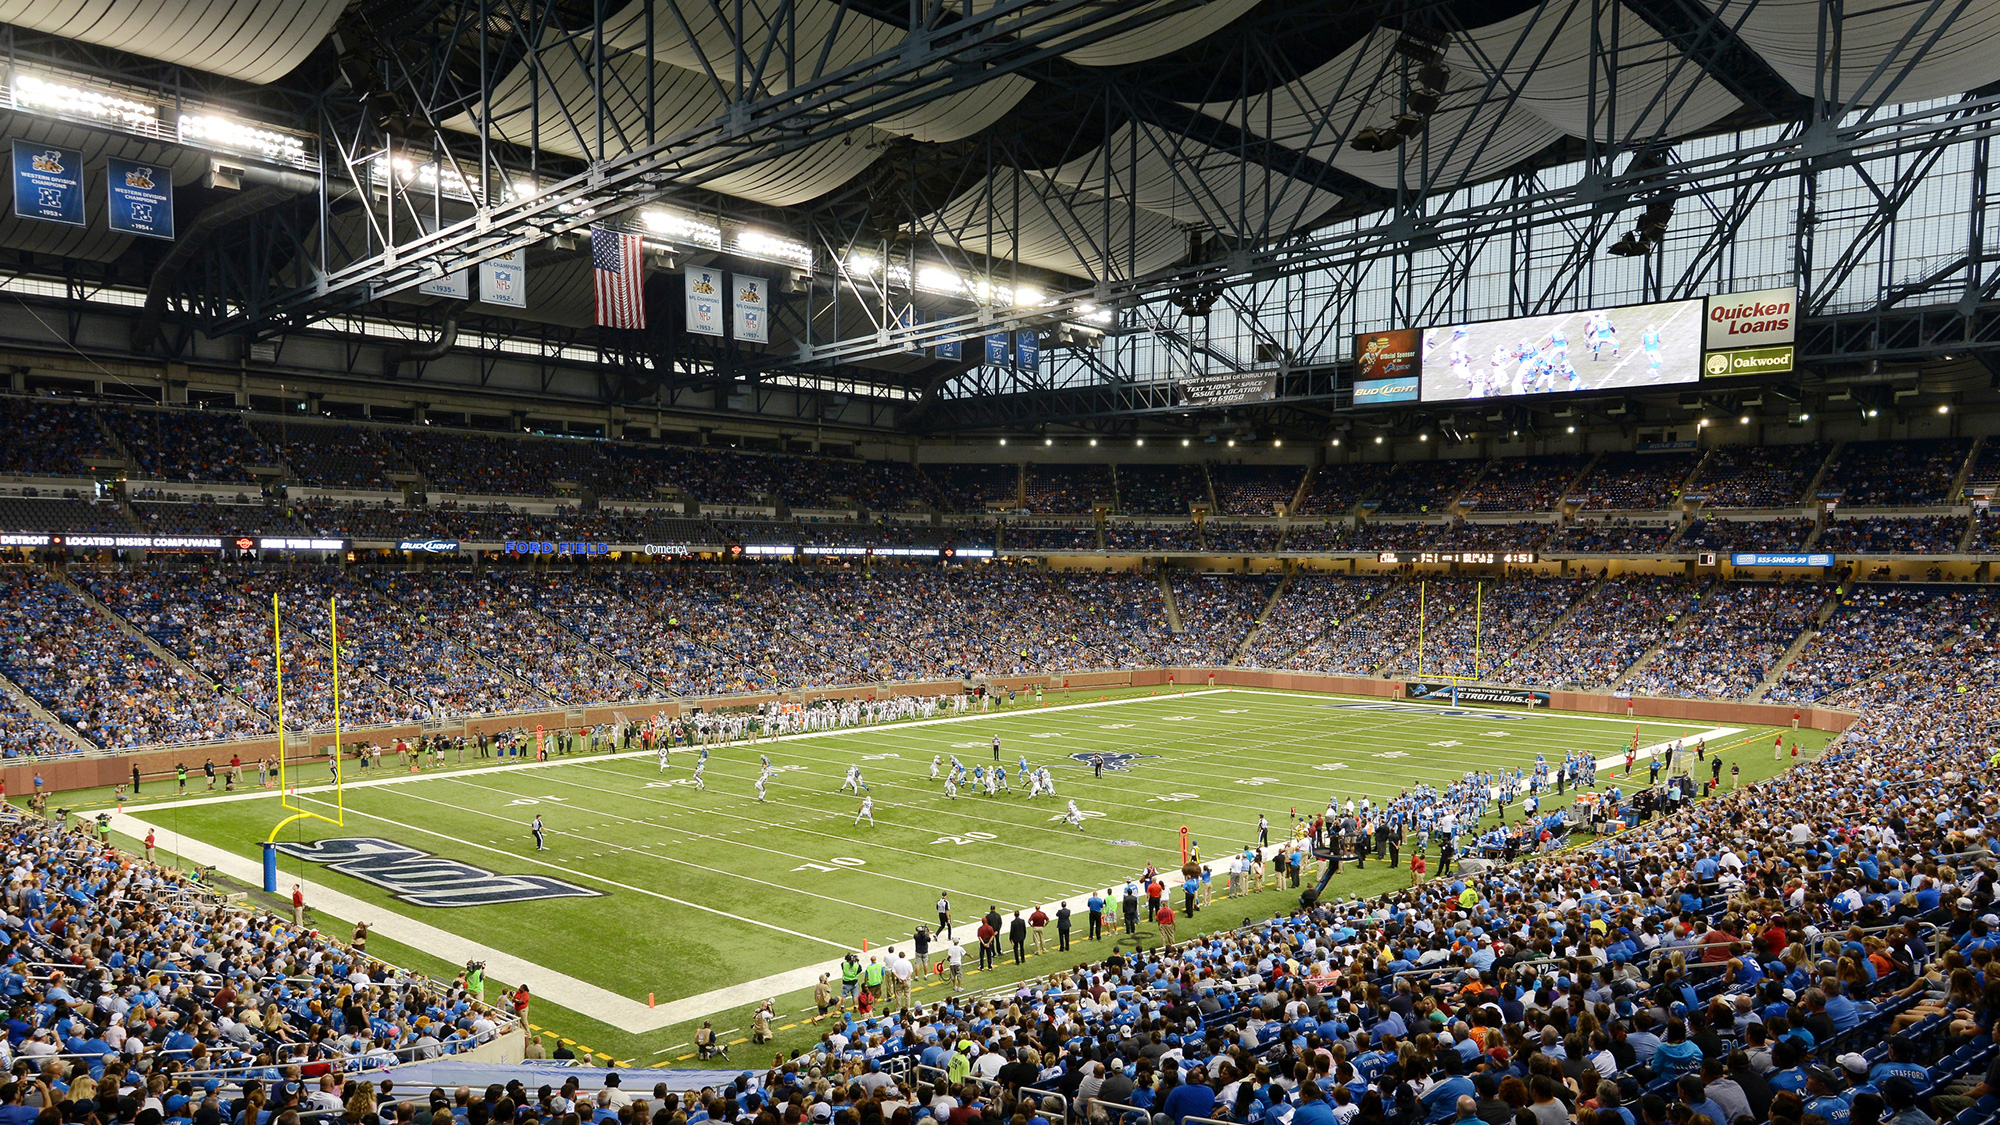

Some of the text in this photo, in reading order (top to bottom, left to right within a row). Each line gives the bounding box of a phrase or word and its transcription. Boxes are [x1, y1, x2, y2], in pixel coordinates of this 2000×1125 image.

[21, 171, 76, 186] WESTERN DIVISION
[32, 179, 68, 189] CHAMPIONS
[114, 187, 166, 200] WESTERN DIVISION
[124, 194, 158, 204] CHAMPIONS
[43, 209, 58, 217] 1953
[494, 262, 522, 272] CHAMPIONS
[698, 296, 720, 304] CHAMPIONS
[1710, 302, 1790, 322] Quicken
[1728, 318, 1790, 335] Loans
[1734, 353, 1790, 368] Oakwood
[1222, 386, 1262, 395] LOCATION
[1218, 394, 1244, 402] 69050
[0, 536, 222, 548] DETROIT LOCATED INSIDE COMPUWARE
[505, 542, 608, 554] FORD FIELD
[1504, 553, 1533, 563] 4:51
[929, 831, 998, 846] 20
[790, 857, 866, 874] 10
[1749, 958, 1760, 970] 9
[1890, 1070, 1924, 1080] STAFFORD
